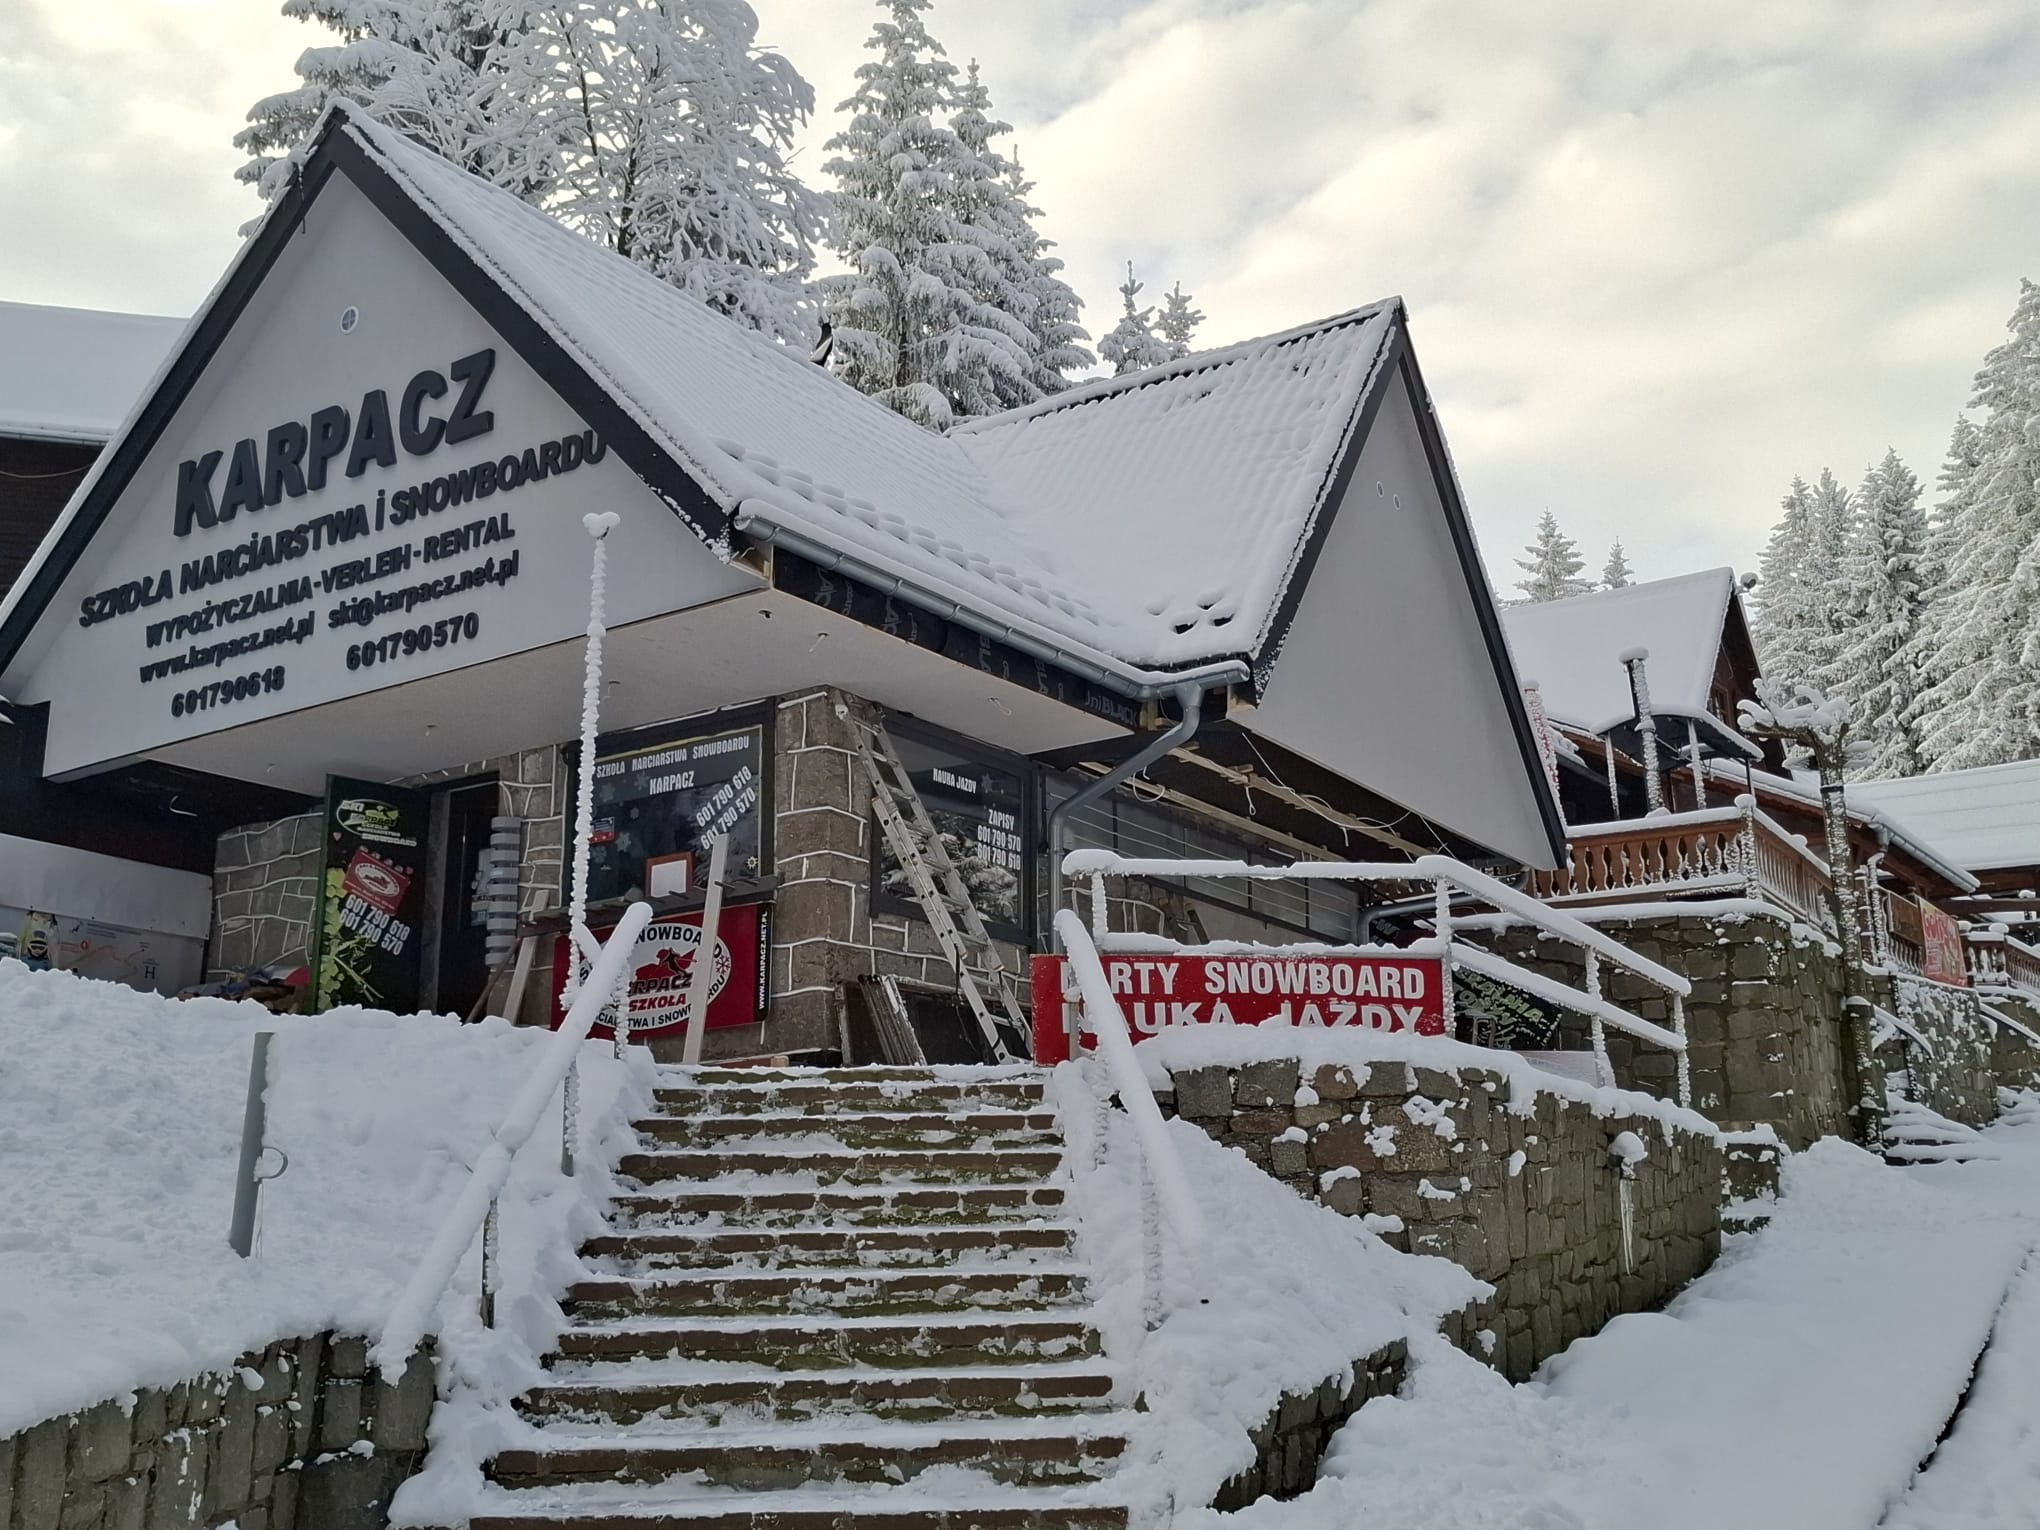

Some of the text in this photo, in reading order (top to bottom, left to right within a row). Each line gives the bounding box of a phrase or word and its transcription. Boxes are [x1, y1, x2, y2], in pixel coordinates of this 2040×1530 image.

[174, 349, 495, 537] KARPACZ
[79, 569, 174, 627] SZKOŁA
[389, 430, 606, 525] SNOWBOARDU
[140, 549, 519, 682] www.karpacz.net.pl ski@karpacz.net.pl
[171, 612, 479, 717] 601790618 601790570
[632, 749, 687, 771] NARCIARSTWA
[692, 735, 749, 759] SNOWBOARDU
[650, 770, 694, 795] KARPACZ
[696, 765, 752, 827] 601 790 618
[933, 767, 977, 794] NAUKA JAZDY
[700, 787, 756, 850] 601 790 570
[988, 809, 1015, 831] ZAPISY
[977, 825, 1021, 852] 601 790 570
[977, 843, 991, 863] 601
[992, 847, 1006, 866] 790
[340, 908, 404, 956] 601 790 570
[345, 894, 368, 916] 601
[366, 905, 390, 929] 790
[389, 920, 411, 941] 618
[635, 925, 722, 959] NOWBOAD
[628, 972, 693, 996] RPACZ
[1205, 961, 1424, 999] SNOWBOARD
[628, 993, 687, 1013] SZKOŁA
[1061, 1002, 1237, 1034] UKA
